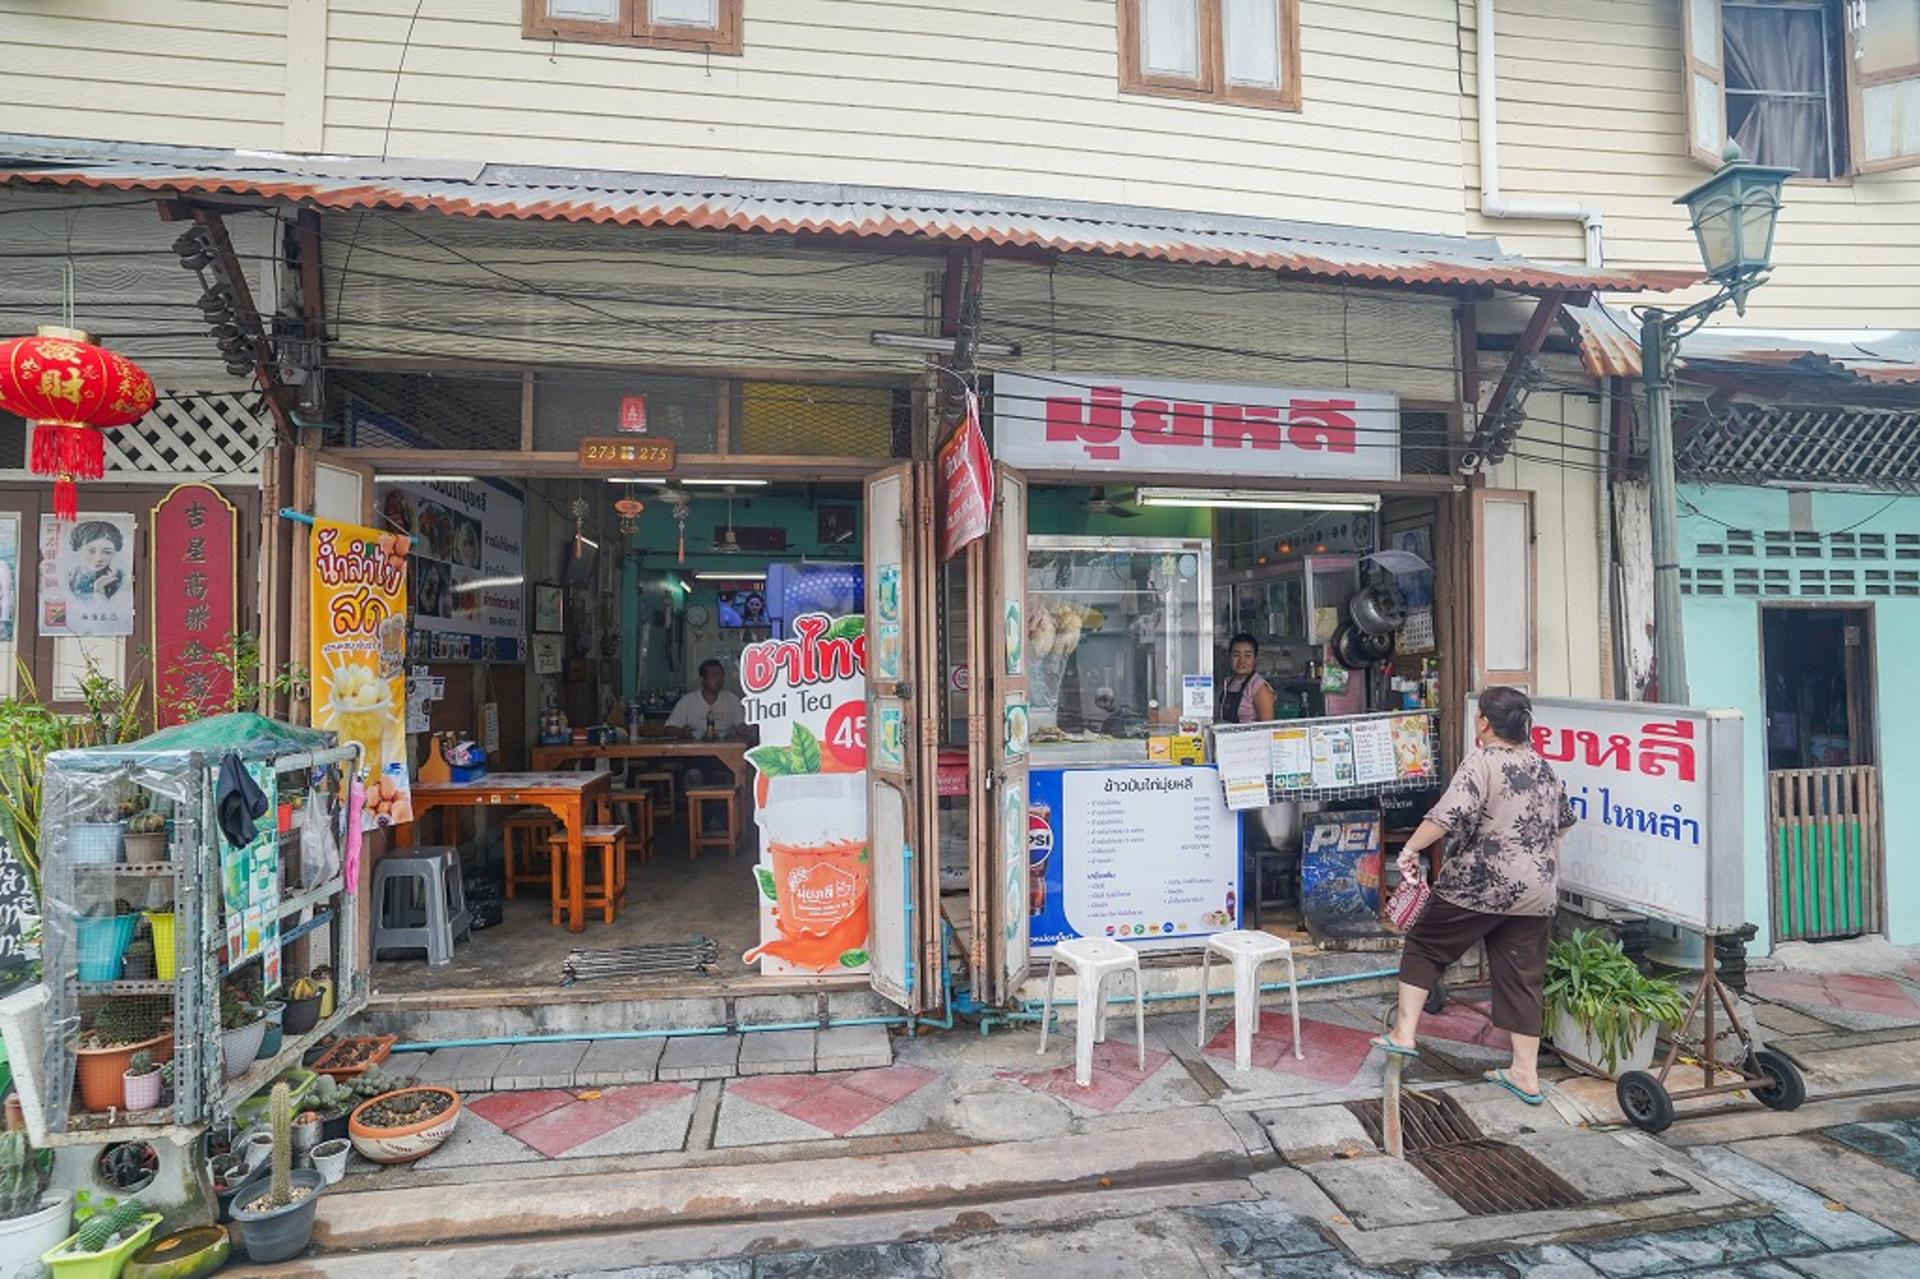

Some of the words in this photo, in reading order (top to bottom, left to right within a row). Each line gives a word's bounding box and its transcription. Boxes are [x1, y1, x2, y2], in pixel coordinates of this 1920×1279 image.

[588, 446, 616, 459] 273
[640, 447, 669, 460] 275
[743, 693, 786, 724] Thai
[797, 689, 832, 714] Tea
[1599, 787, 1699, 844] ไหหลำ
